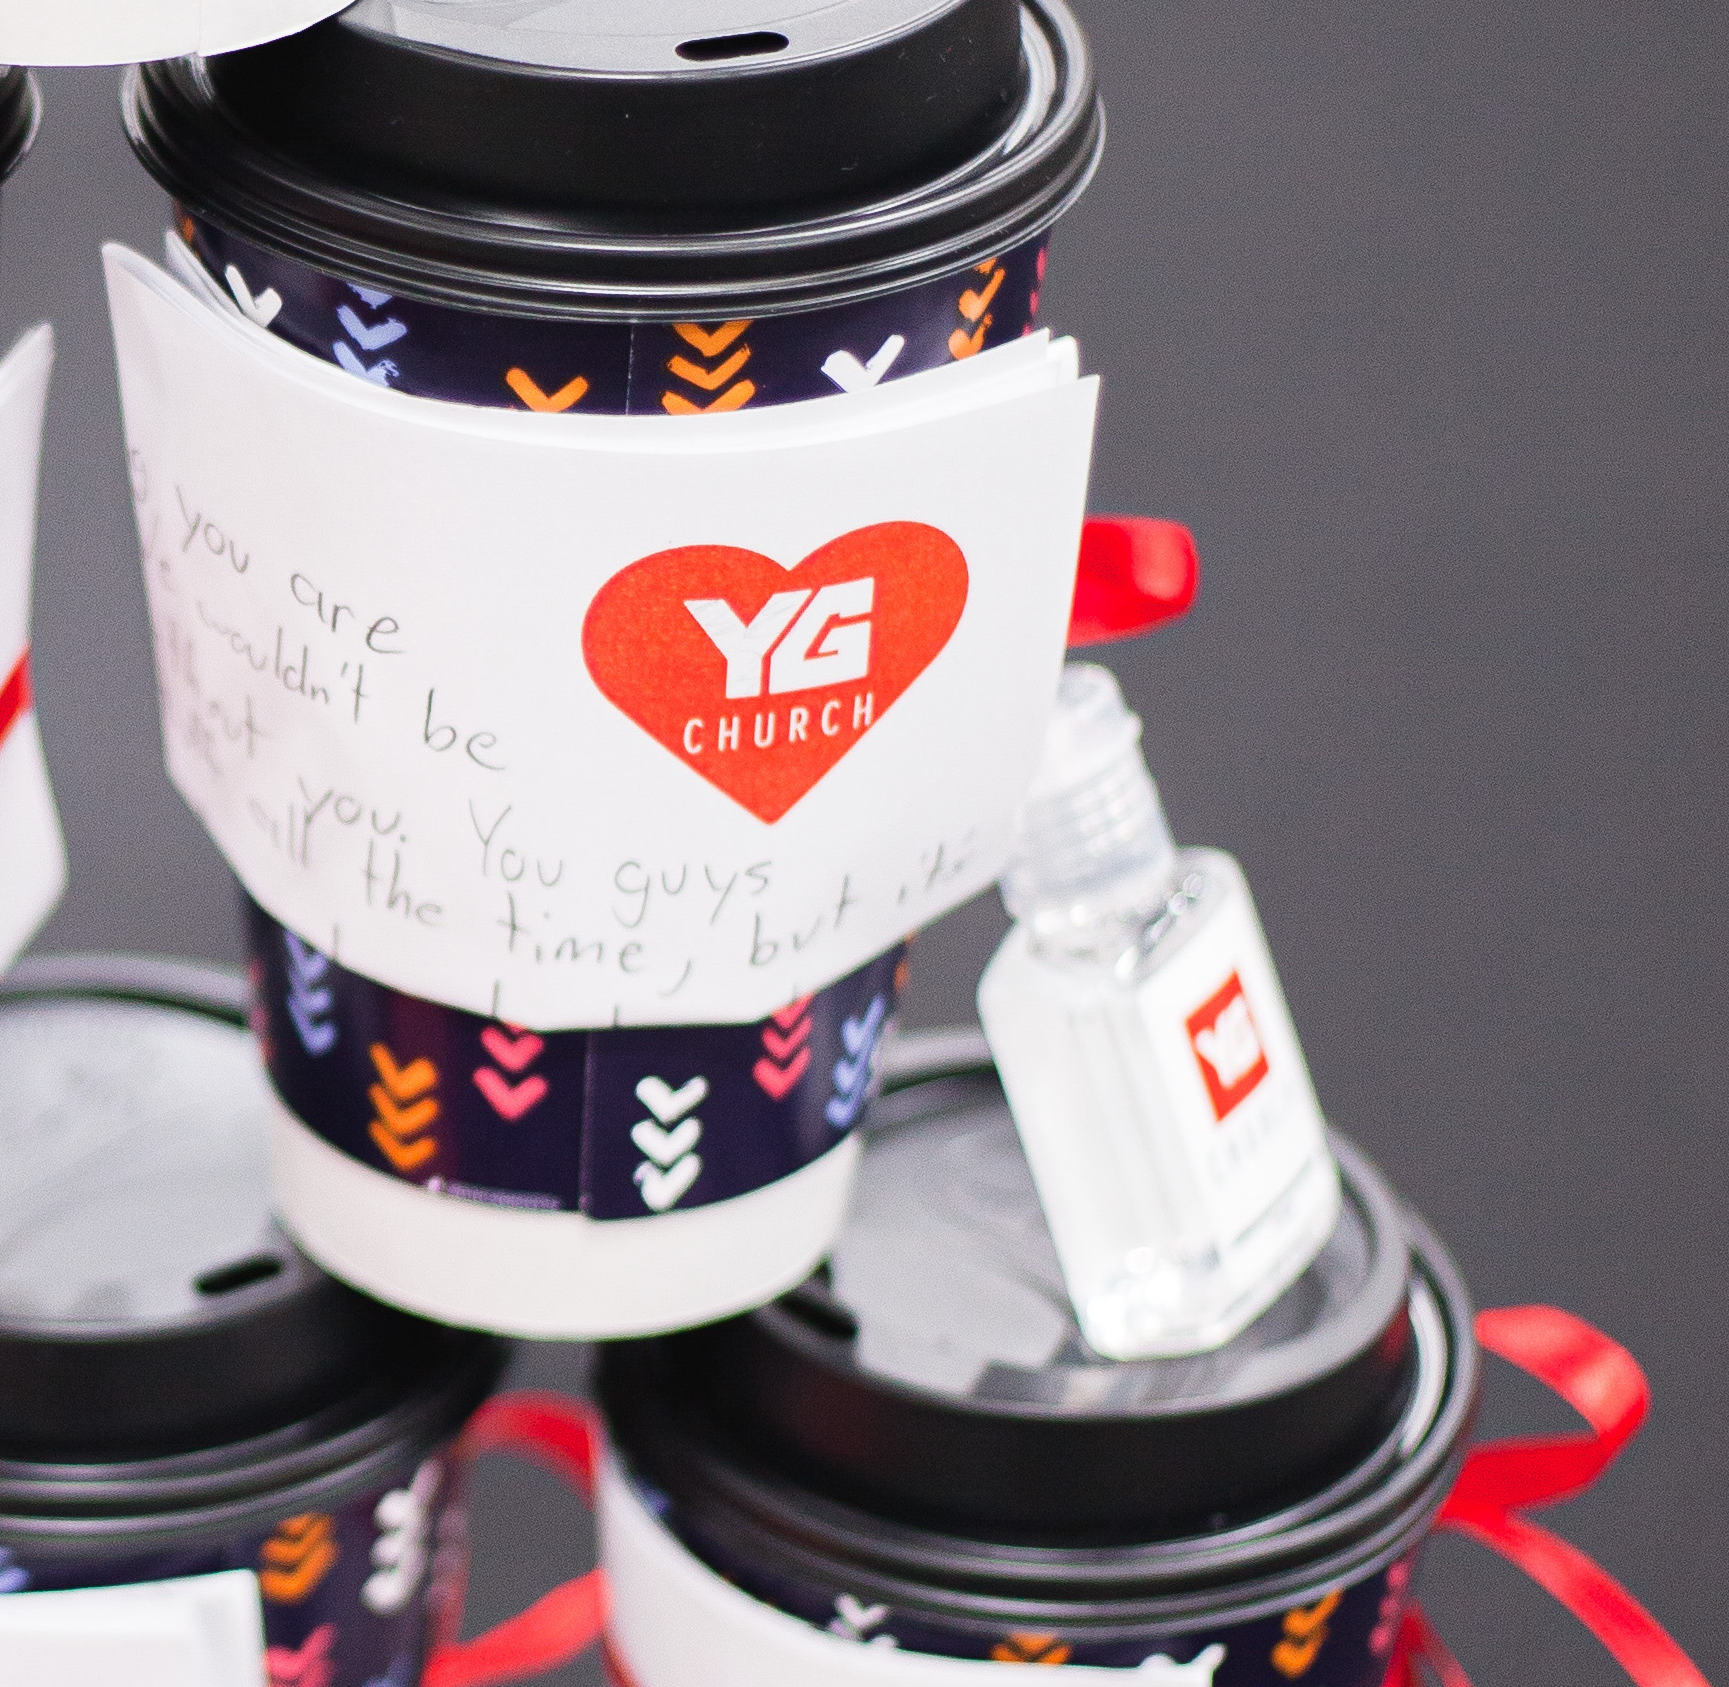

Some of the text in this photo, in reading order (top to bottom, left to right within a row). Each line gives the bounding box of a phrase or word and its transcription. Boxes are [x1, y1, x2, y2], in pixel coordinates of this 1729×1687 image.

[175, 482, 251, 575] you
[289, 570, 407, 656] are
[682, 577, 875, 700] YG
[419, 686, 507, 772] be
[682, 692, 875, 755] CHURCH
[468, 796, 564, 877] You
[611, 858, 774, 930] guys
[749, 873, 859, 968] but
